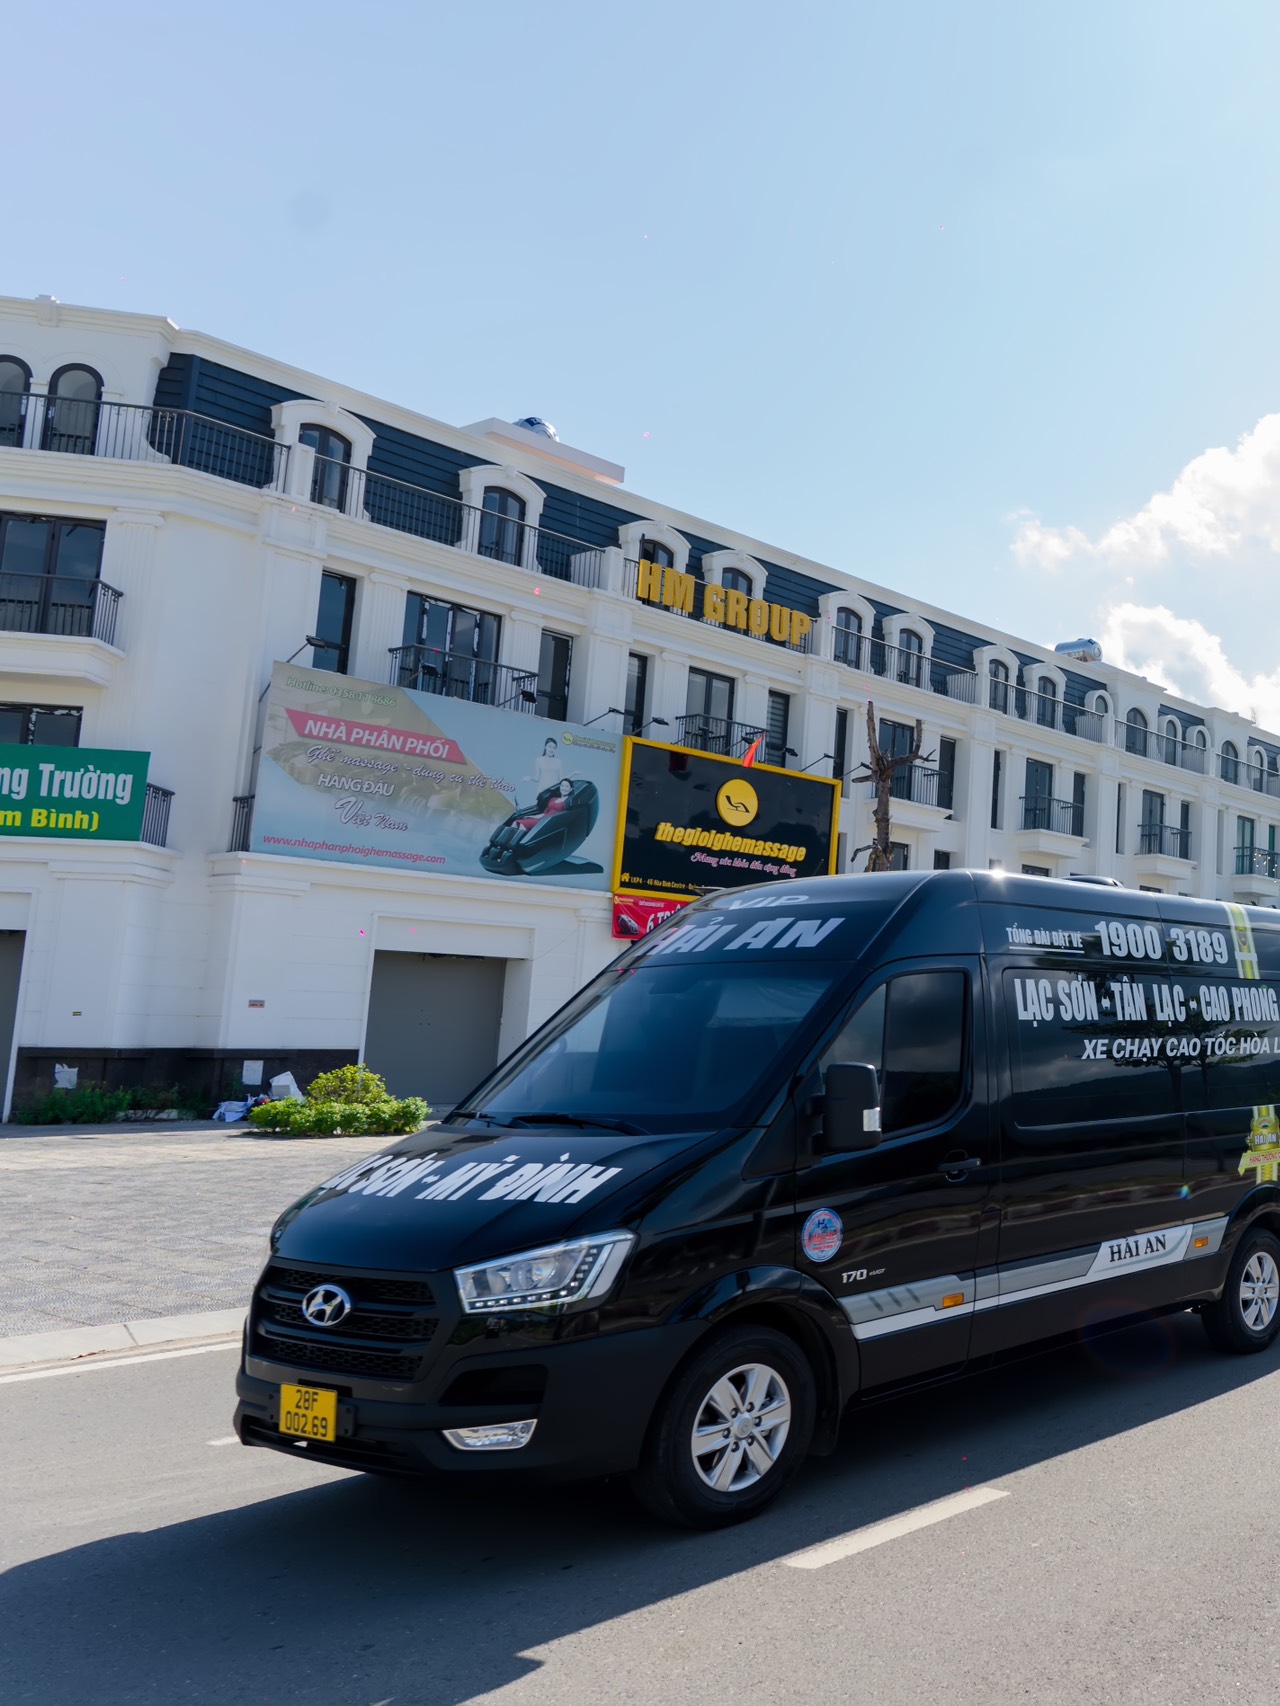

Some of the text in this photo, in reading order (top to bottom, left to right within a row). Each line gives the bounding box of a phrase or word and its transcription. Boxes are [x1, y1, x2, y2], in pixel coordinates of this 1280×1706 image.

[637, 559, 811, 646] HM GROUP
[286, 677, 327, 694] Hotline:
[304, 719, 449, 759] NHÀ PHÂN PHỐI
[340, 753, 398, 775] massage
[39, 763, 134, 805] Trường
[317, 774, 395, 797] HÀNG ĐẦU
[31, 808, 99, 832] Bình)
[374, 813, 409, 831] Nam
[262, 834, 446, 865] www.nhaphanphoighemassage.com
[729, 895, 809, 910] VIP
[634, 916, 846, 957] HẢI AN
[1006, 922, 1033, 945] TỔNG
[1034, 927, 1051, 946] ĐÀI
[1052, 929, 1070, 949] ĐẶT
[1095, 920, 1163, 960] 1900
[1170, 927, 1229, 965] 3189
[1014, 978, 1055, 1028] LẠC
[1057, 974, 1100, 1021] SƠN
[1110, 975, 1148, 1021] TÂN
[1152, 983, 1187, 1027] LẠC
[1199, 984, 1231, 1022] CAO
[1231, 986, 1280, 1022] PHONG
[1081, 1039, 1109, 1060] XE
[1112, 1037, 1163, 1062] CHẠY
[1166, 1037, 1201, 1058] CAO
[1205, 1030, 1237, 1056] TỐC
[1239, 1031, 1271, 1055] HÒA
[477, 1152, 623, 1204] ĐÌNH
[1108, 1233, 1167, 1263] HẢI AN
[842, 1268, 868, 1284] 170
[295, 1389, 319, 1412] 28F
[285, 1410, 328, 1438] 002.69
